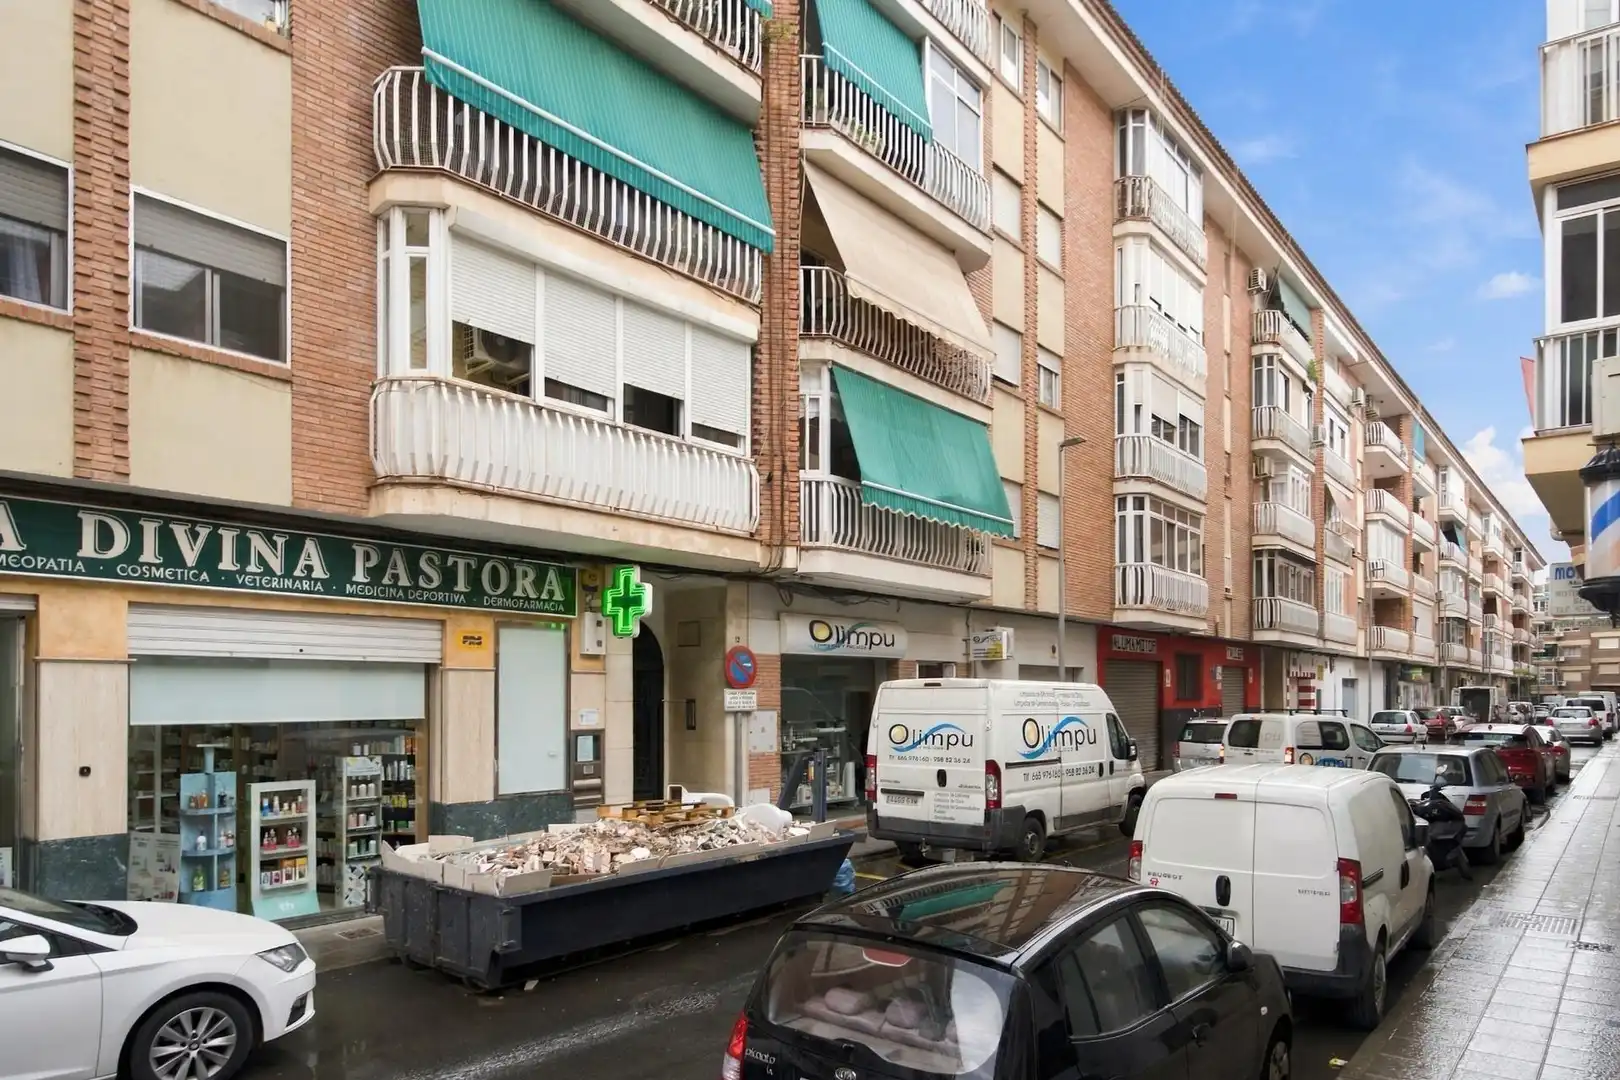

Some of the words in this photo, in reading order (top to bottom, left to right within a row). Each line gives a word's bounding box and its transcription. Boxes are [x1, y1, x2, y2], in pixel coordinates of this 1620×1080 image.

[77, 507, 330, 579] DIVINA
[352, 542, 565, 601] PASTORA
[116, 563, 209, 582] COSMETICA
[236, 573, 324, 592] VETERINARIA
[346, 583, 404, 600] MEDICINA
[408, 589, 466, 604] DEPORTIVA
[483, 595, 565, 612] DERMOFARMACIA
[809, 620, 895, 650] Olimpu
[888, 723, 974, 750] Olimpu
[1022, 717, 1097, 751] Olimpu
